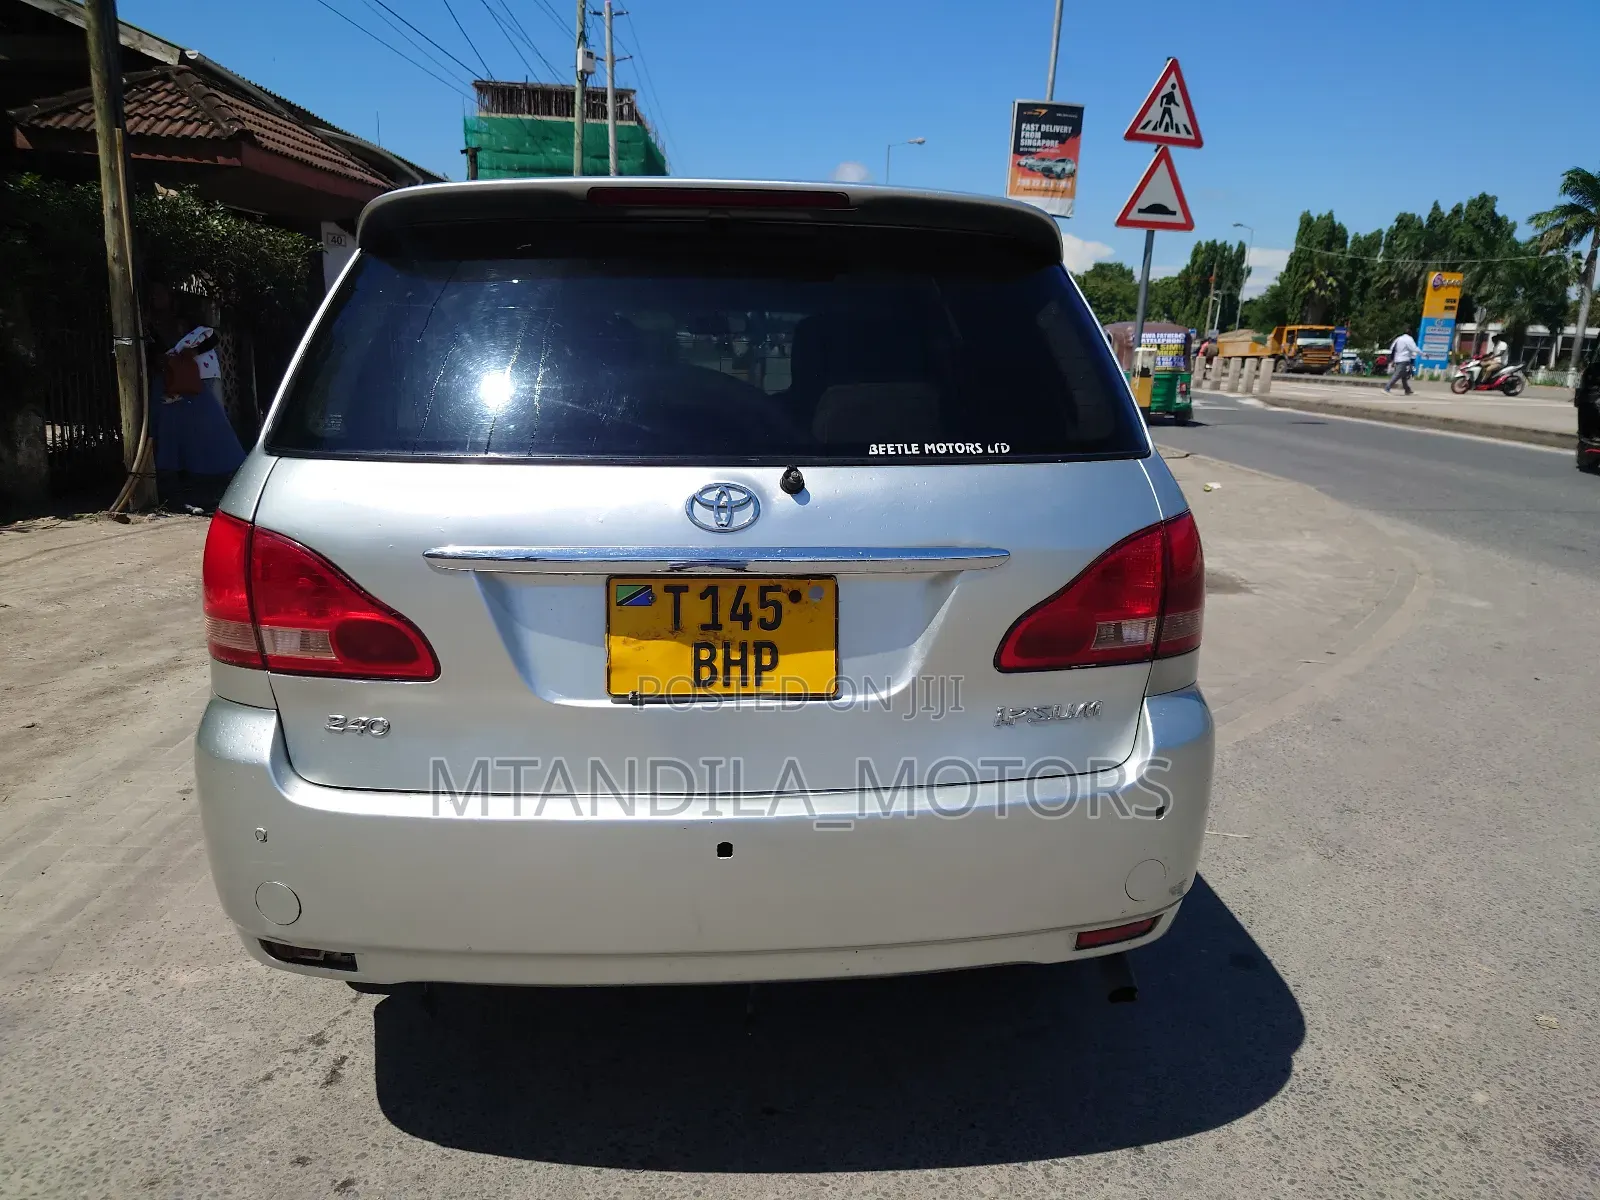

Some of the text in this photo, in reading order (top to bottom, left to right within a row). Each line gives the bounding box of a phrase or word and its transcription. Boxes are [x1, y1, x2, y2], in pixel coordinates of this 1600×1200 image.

[1021, 123, 1072, 134] FAST DELIVERY
[1020, 131, 1041, 139] FROM
[1020, 138, 1059, 147] SINGAPORE
[331, 236, 342, 245] 40
[868, 443, 921, 455] BEETLE
[924, 443, 984, 455] MOTORS
[692, 640, 779, 688] BHP
[993, 700, 1103, 728] IPSUM
[324, 714, 390, 736] 240
